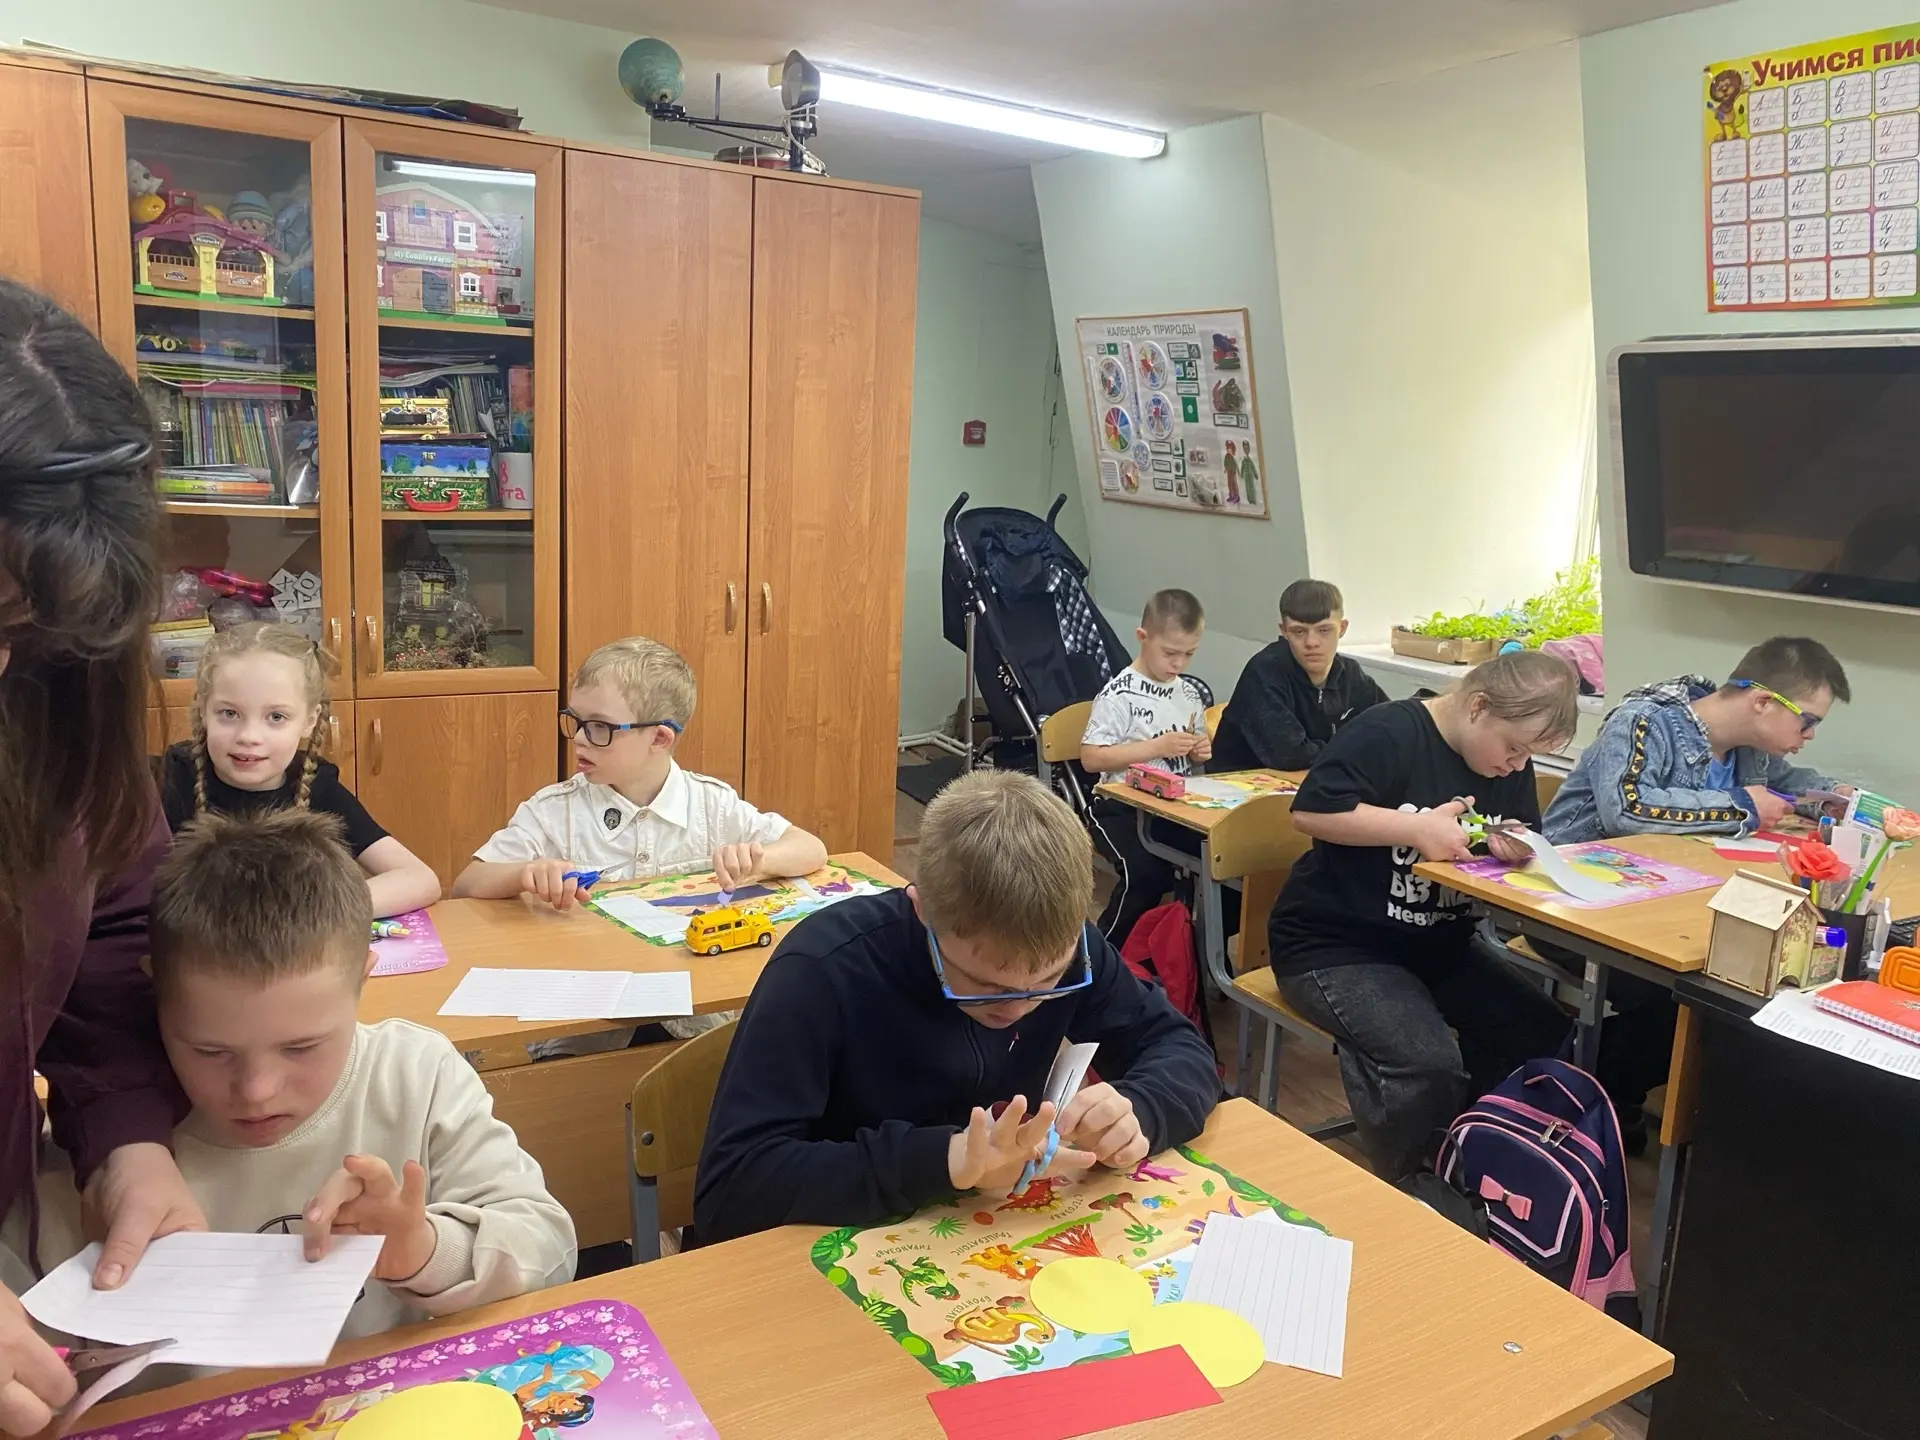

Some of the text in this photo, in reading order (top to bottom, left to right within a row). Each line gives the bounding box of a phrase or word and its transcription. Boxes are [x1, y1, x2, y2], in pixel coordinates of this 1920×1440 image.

[1752, 38, 1920, 86] Учимся пи
[1107, 323, 1196, 338] КАЛЕНДАРЬ ПРИРОДЫ
